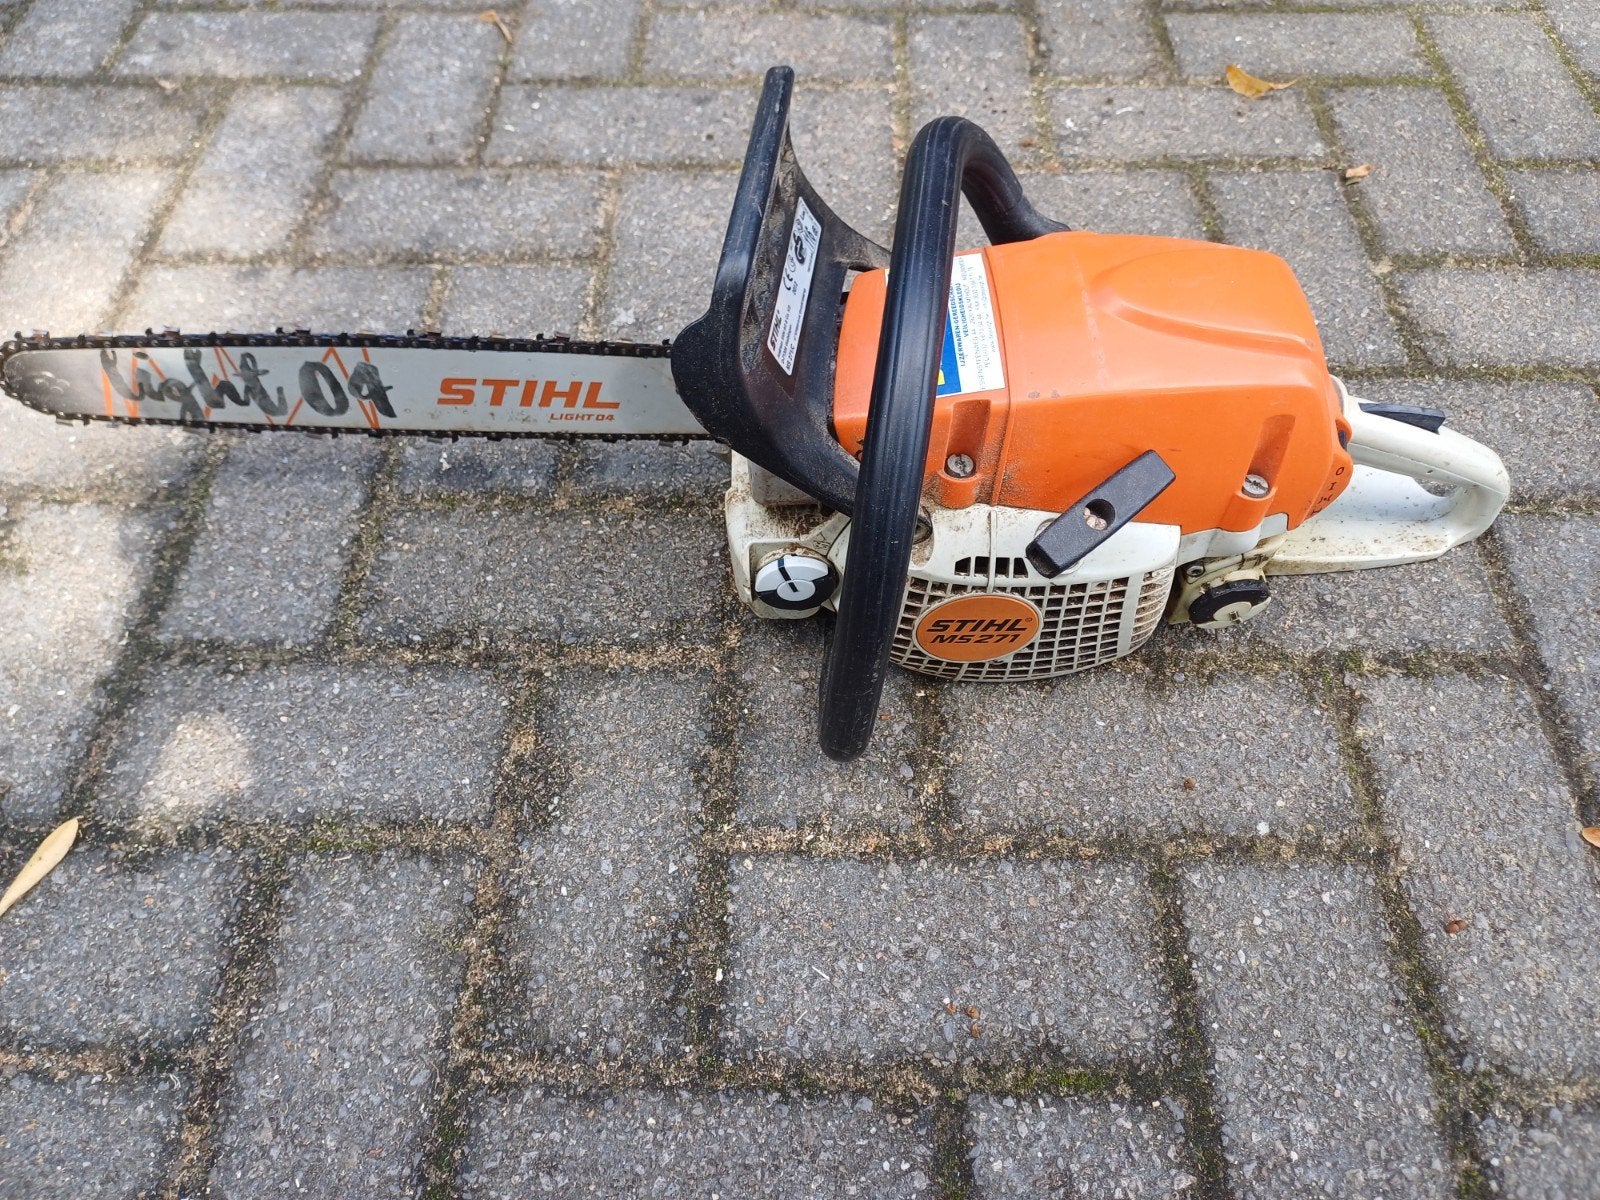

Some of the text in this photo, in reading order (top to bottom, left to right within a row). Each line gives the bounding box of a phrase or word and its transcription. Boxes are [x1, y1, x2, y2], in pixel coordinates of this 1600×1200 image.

[437, 377, 620, 409] STIHL
[550, 413, 595, 421] LIGHT
[926, 619, 1027, 633] STIHL
[930, 633, 1021, 644] MS 271
